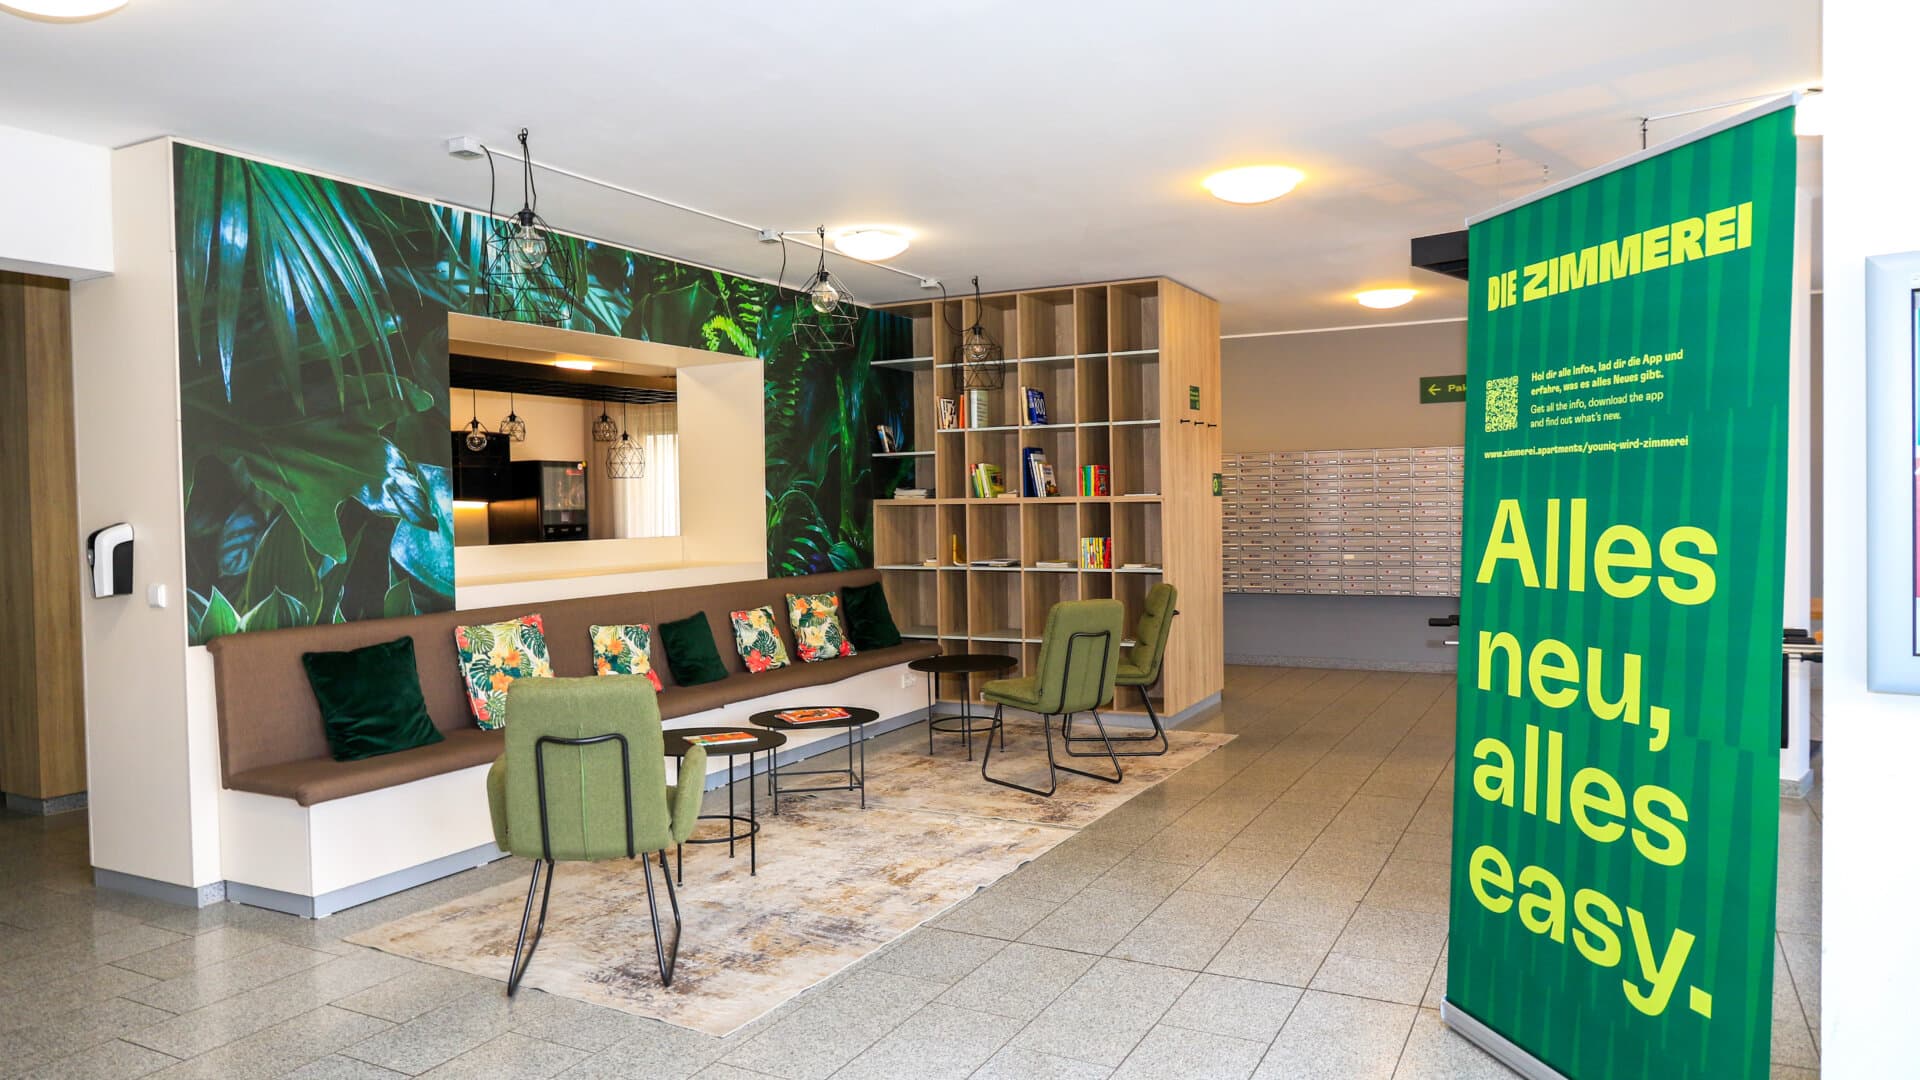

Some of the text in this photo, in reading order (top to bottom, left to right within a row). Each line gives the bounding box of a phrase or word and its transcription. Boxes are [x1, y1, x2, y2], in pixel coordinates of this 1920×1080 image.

[1488, 201, 1752, 312] DIE ZIMMEREI
[1531, 370, 1664, 396] erfahre, was es alles Neues gibt.
[1532, 372, 1544, 382] Hol
[1546, 370, 1557, 380] dir
[1558, 367, 1571, 378] alle
[1599, 360, 1612, 372] lad
[1614, 358, 1626, 369] dir
[1628, 356, 1641, 367] die
[1642, 354, 1662, 365] App
[1665, 348, 1684, 361] und
[1530, 417, 1544, 428] and
[1546, 415, 1559, 426] find
[1560, 416, 1573, 425] out
[1603, 412, 1621, 421] new.
[1531, 391, 1664, 414] Get all the info, download the app
[1484, 436, 1689, 459] www.zimmerei.apartments/youniq-wird-zimmerei
[1476, 497, 1719, 605] Alles
[1477, 629, 1671, 752] neu,
[1472, 723, 1689, 867] alles
[1468, 844, 1713, 1019] easy.
